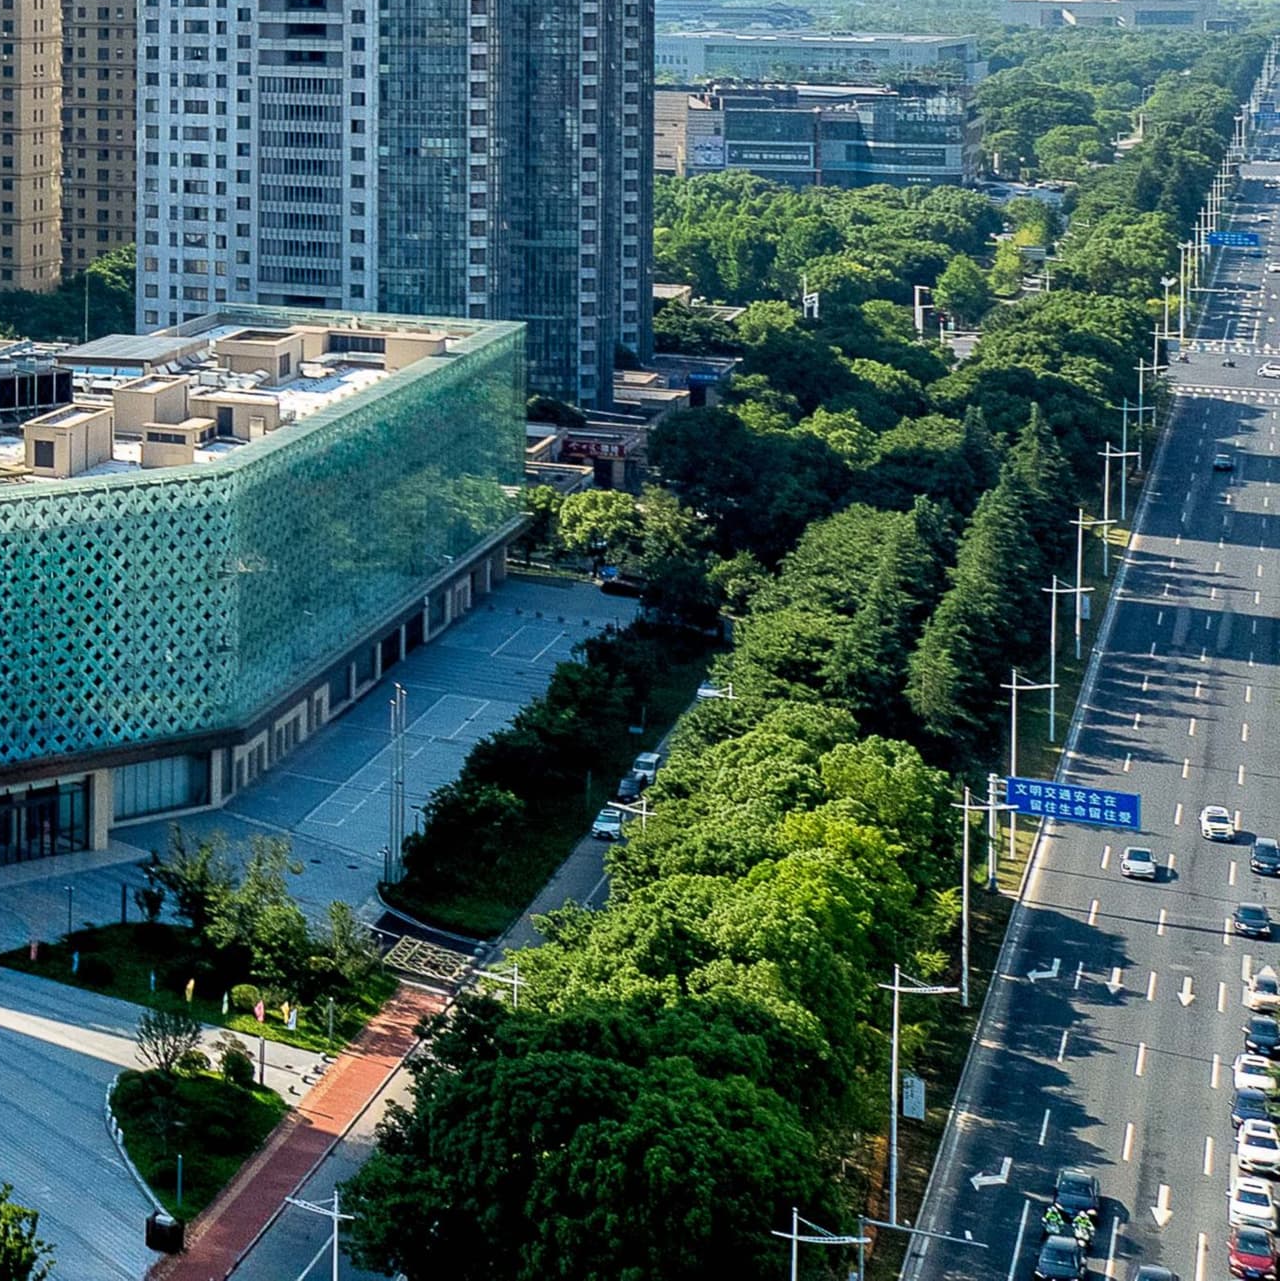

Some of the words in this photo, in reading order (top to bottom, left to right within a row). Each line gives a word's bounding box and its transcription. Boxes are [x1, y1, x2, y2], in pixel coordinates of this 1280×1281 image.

[1015, 783, 1118, 807] 文明交通安全在
[1030, 799, 1132, 823] 留住生命留住爱
